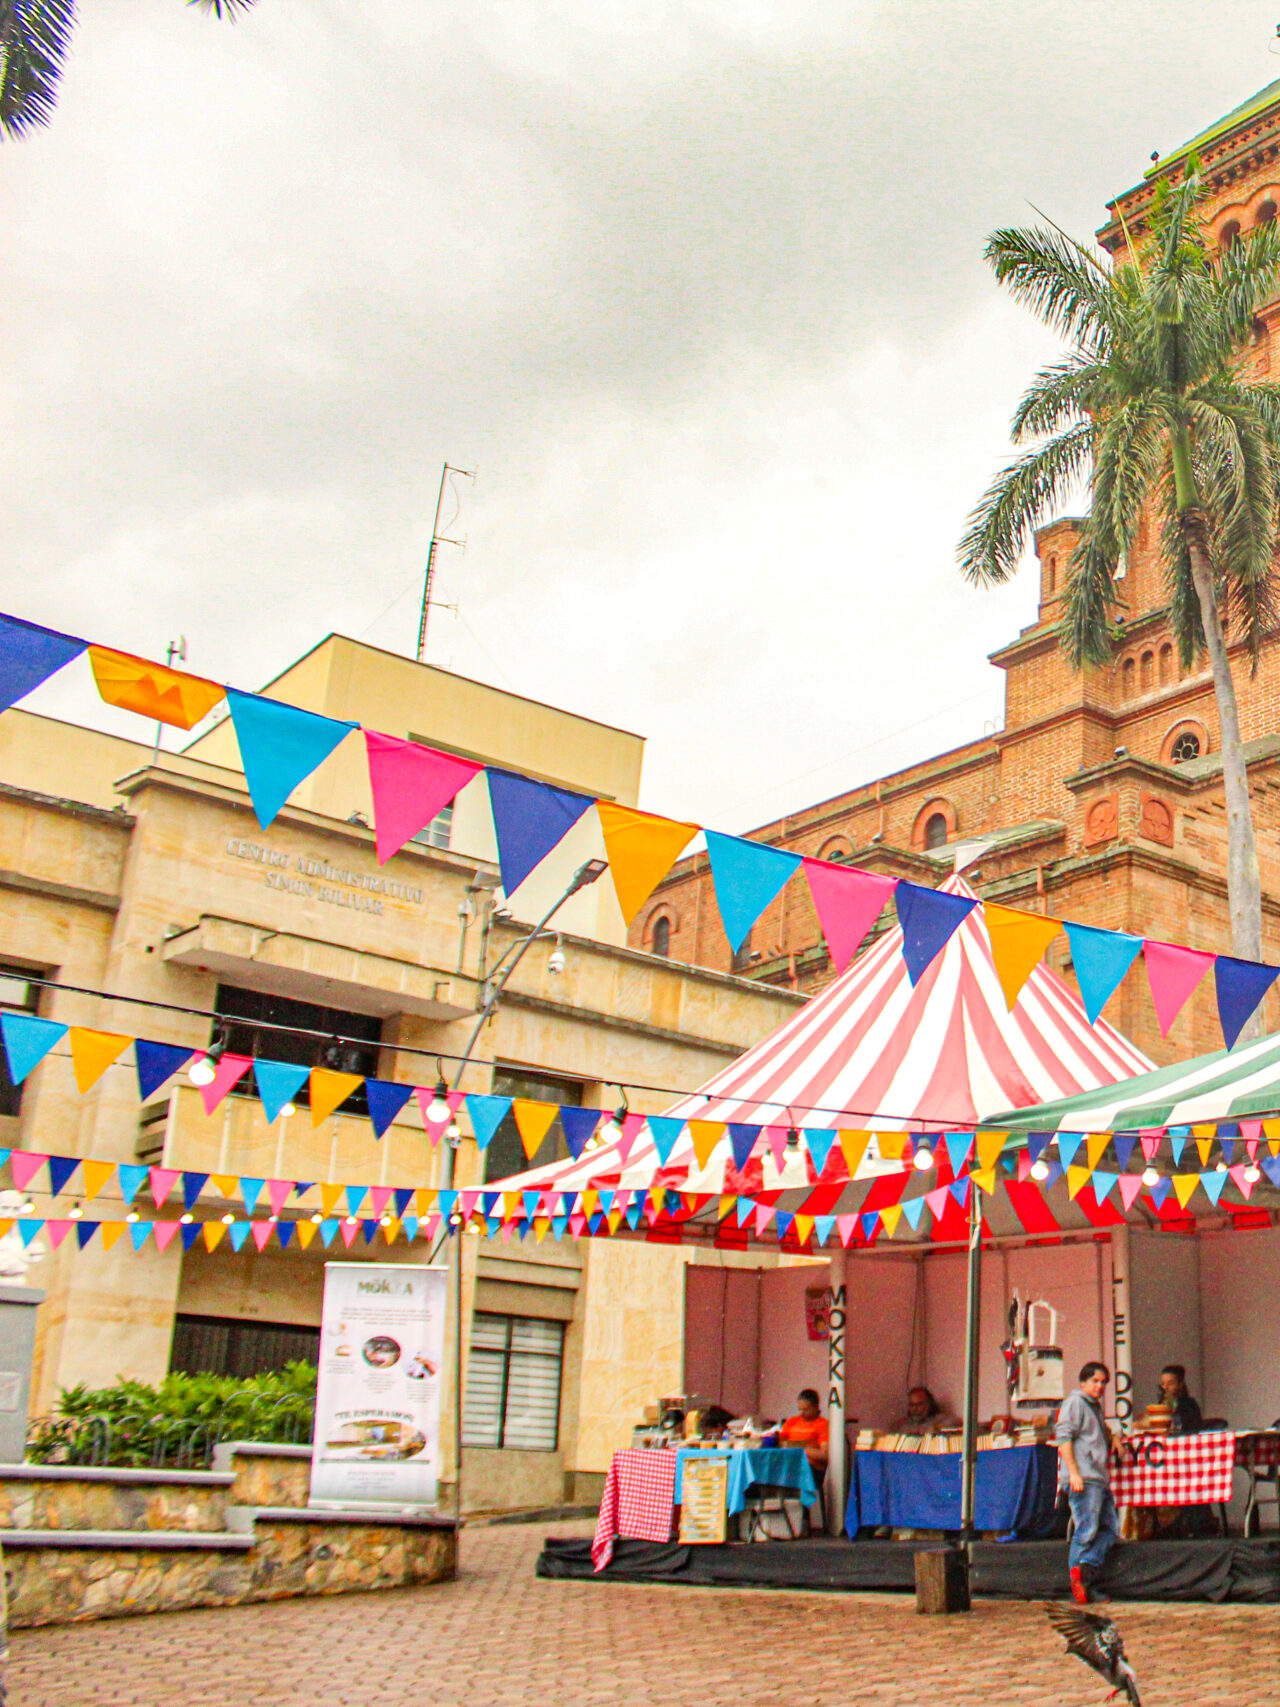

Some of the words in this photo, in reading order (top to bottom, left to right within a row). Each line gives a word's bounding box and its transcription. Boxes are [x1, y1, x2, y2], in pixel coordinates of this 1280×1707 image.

[227, 839, 291, 868] CENTRO
[295, 859, 424, 904] ADMINISTRATIVO
[828, 1284, 847, 1409] MOKKA
